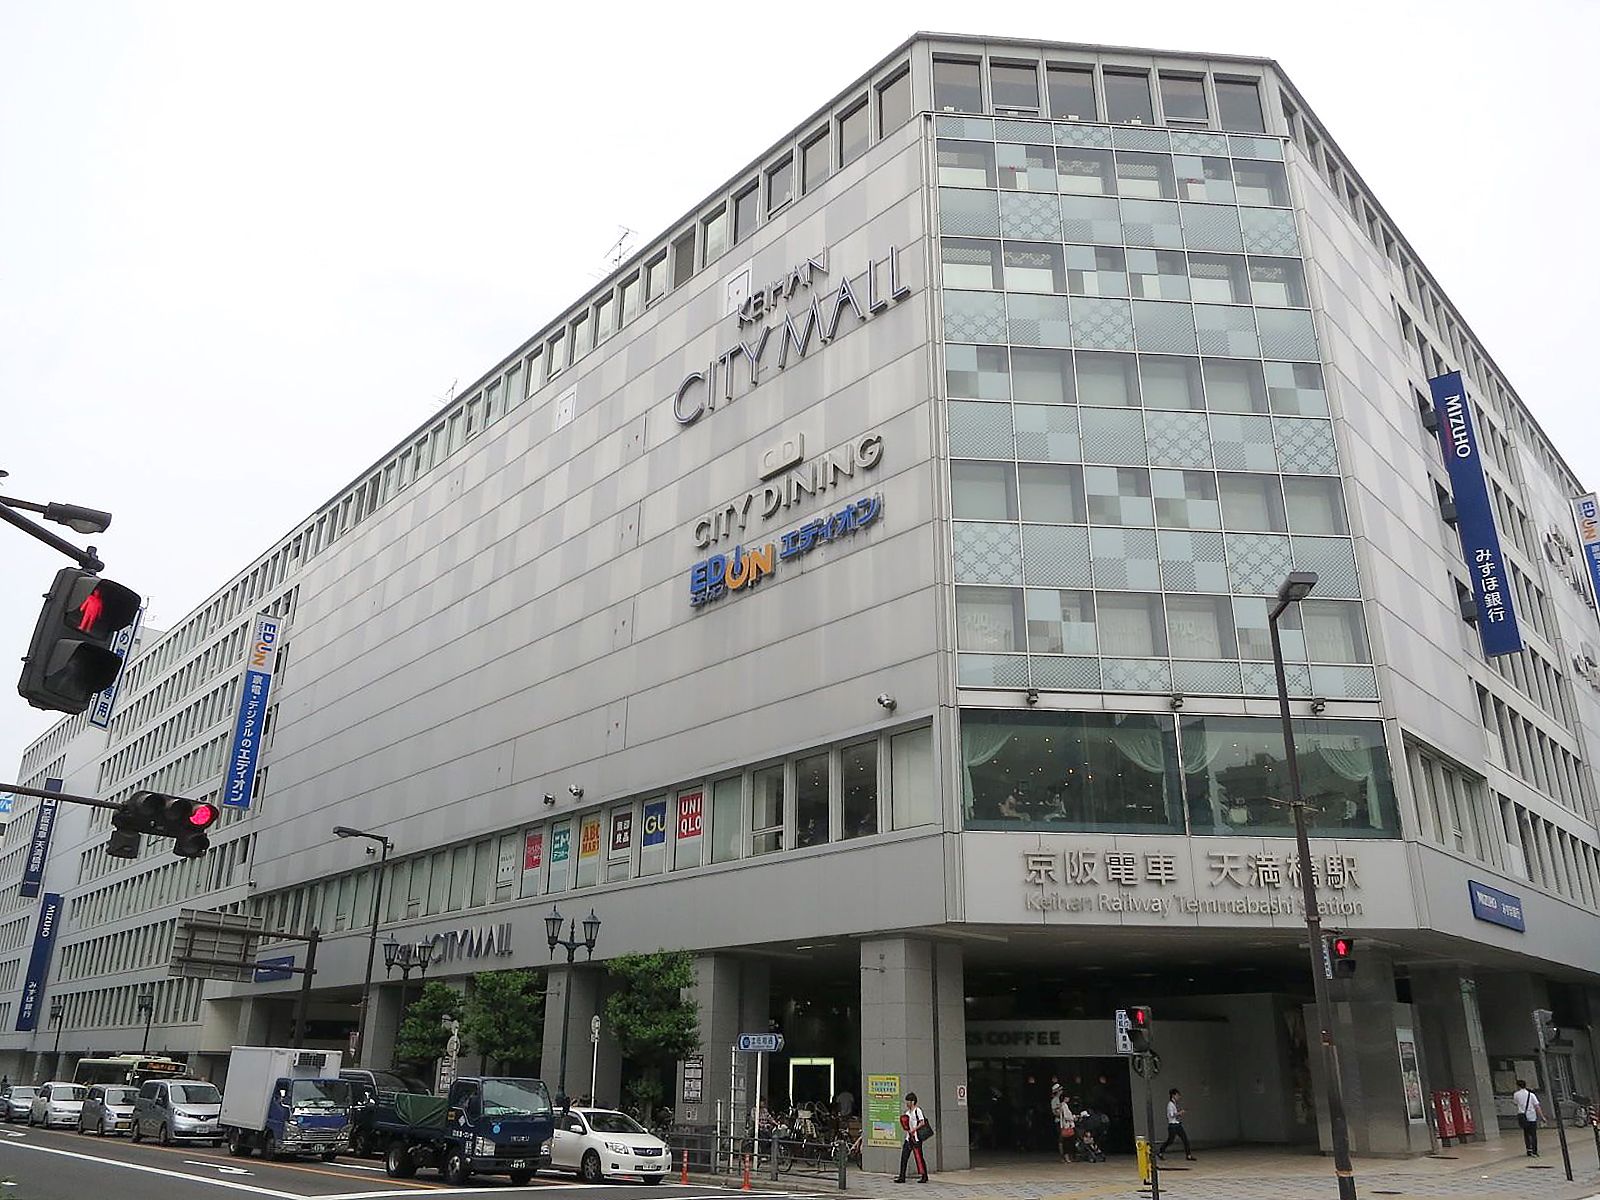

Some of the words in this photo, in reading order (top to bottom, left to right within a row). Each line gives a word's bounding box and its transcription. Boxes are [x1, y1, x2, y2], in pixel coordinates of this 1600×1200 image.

[1444, 394, 1472, 459] MIZUHO
[693, 493, 754, 549] CITY
[760, 432, 885, 520] DINING
[779, 491, 886, 560] エディオン
[1475, 549, 1506, 623] みずほ銀行
[645, 814, 667, 834] GU
[1023, 849, 1179, 887] 京阪電車
[1207, 850, 1362, 890] 天満橋駅
[41, 904, 56, 938] MIZUHO
[1026, 892, 1093, 911] Keihan
[1098, 893, 1172, 919] Railway
[1297, 897, 1363, 916] Sation
[986, 1030, 1062, 1046] COFFEE
